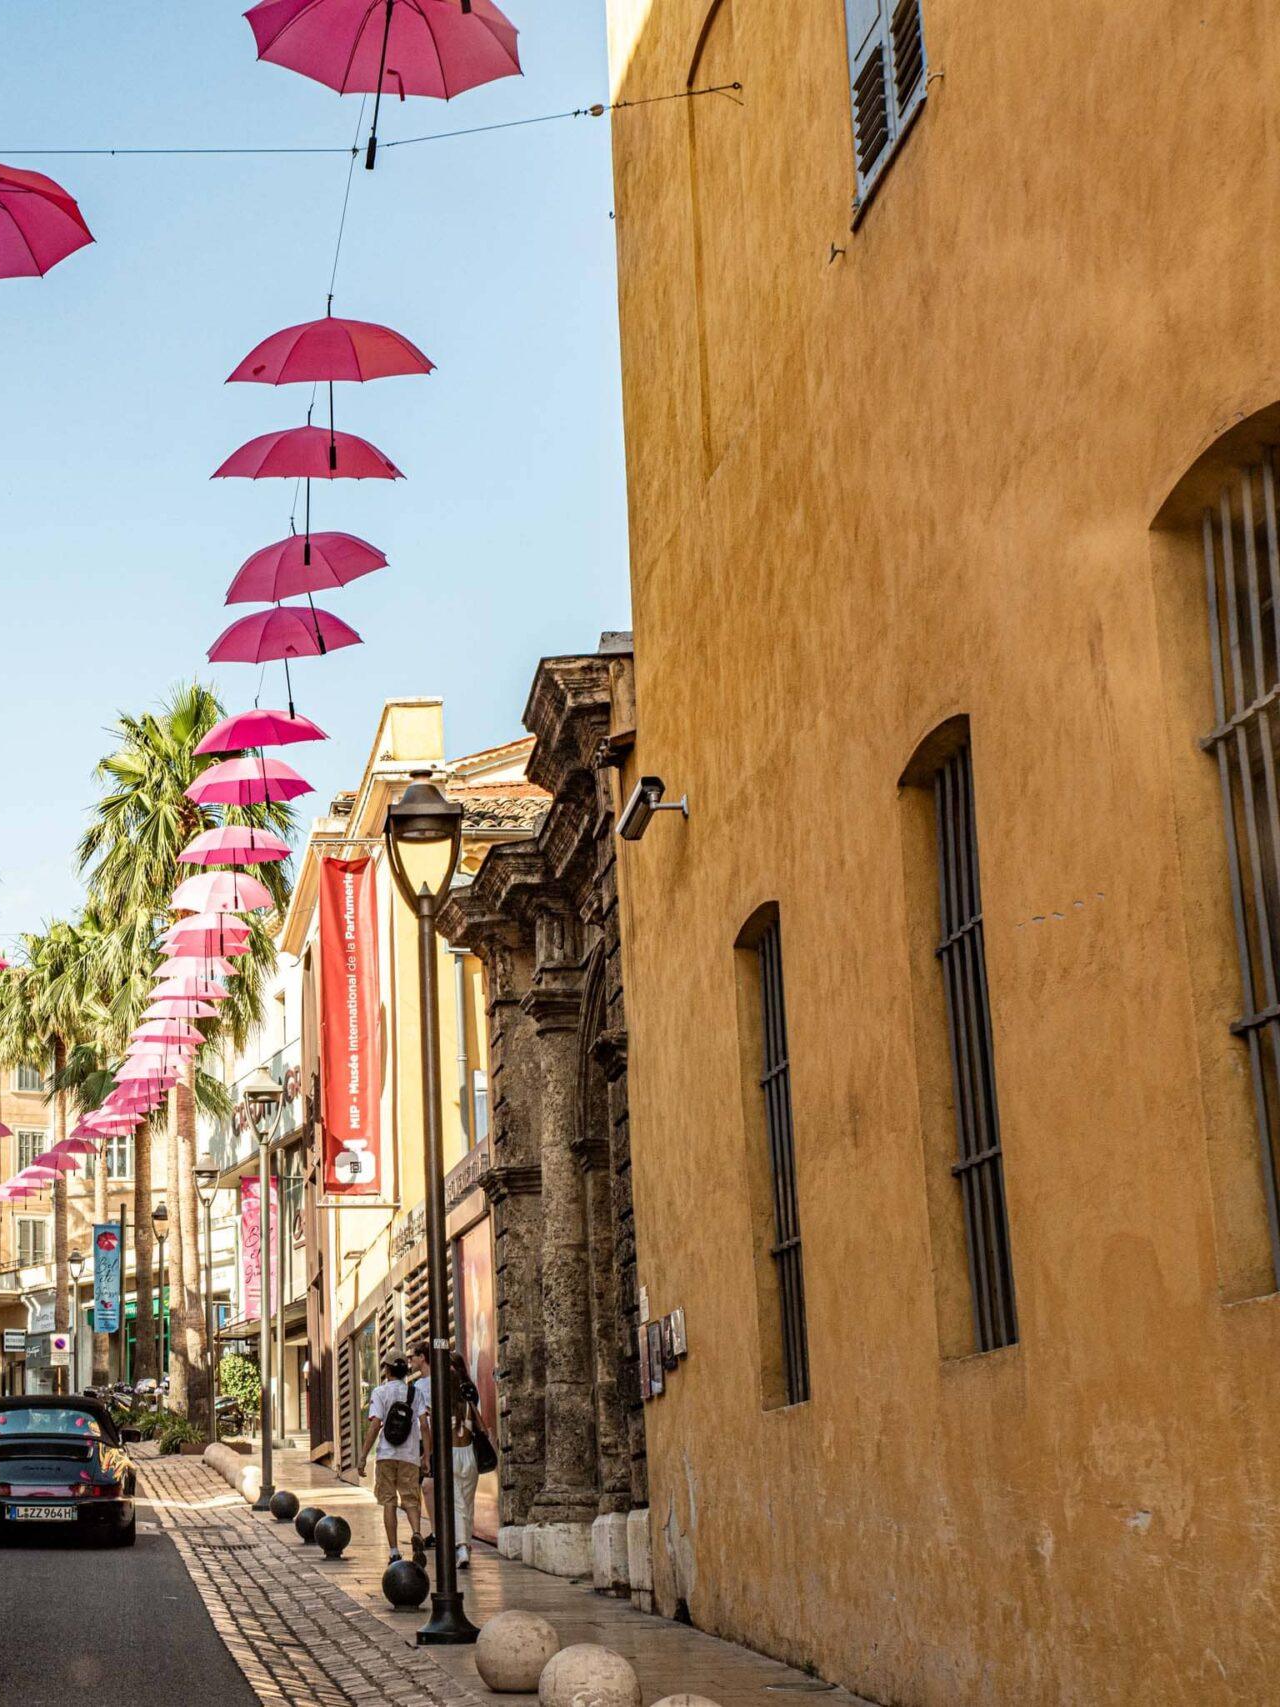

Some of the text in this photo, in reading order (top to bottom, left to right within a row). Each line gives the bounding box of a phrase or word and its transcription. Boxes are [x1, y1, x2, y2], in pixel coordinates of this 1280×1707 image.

[343, 872, 355, 940] Parfumerie
[346, 943, 355, 952] la
[347, 956, 356, 971] de
[347, 975, 359, 1051] International
[349, 1105, 360, 1130] MIP
